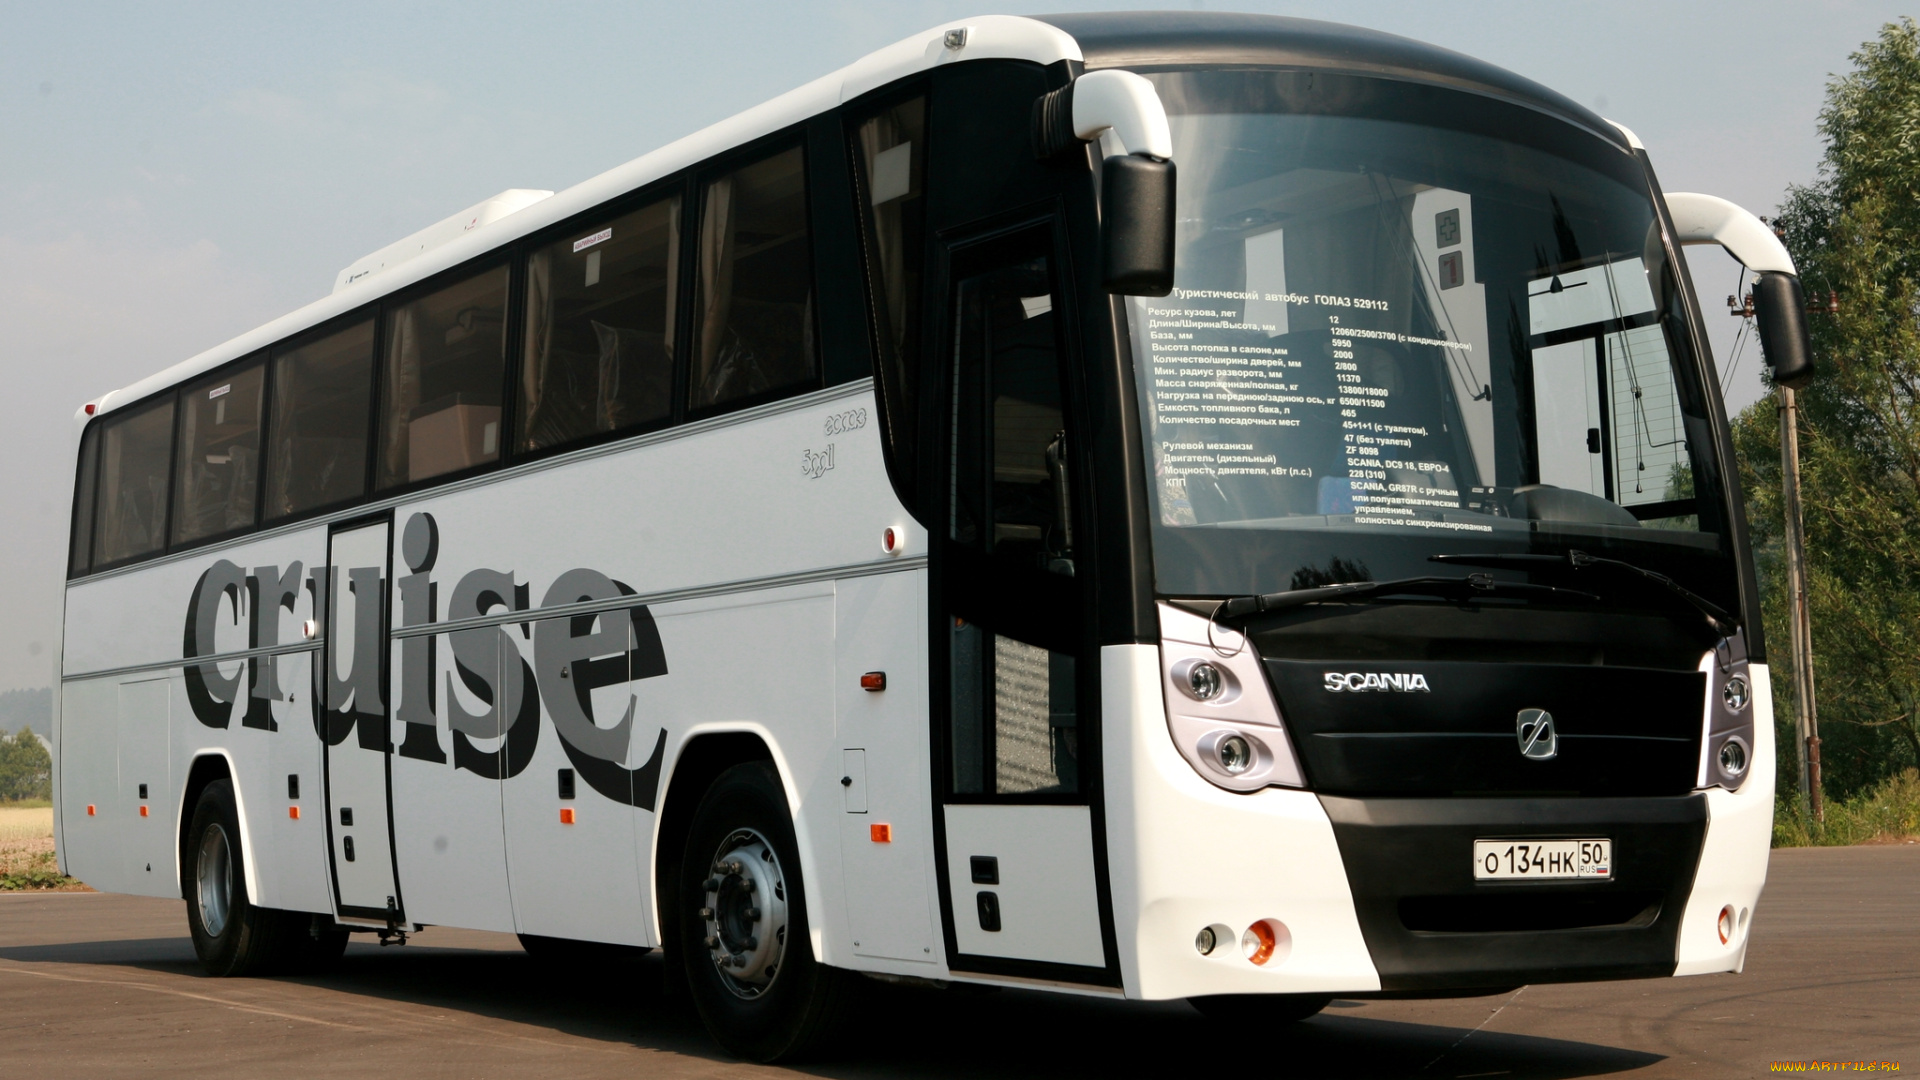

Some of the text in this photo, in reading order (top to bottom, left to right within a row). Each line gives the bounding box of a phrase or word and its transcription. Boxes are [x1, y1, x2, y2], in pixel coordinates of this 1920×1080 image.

[1172, 288, 1388, 310] Туристический автобус ГОЛАЗ 529112
[1148, 308, 1182, 317] Ресурс
[1184, 309, 1218, 318] кузова,
[1150, 331, 1177, 341] База,
[1330, 328, 1472, 352] 12060/2500/3700 (с кондиционером)
[1152, 343, 1189, 352] Высота
[1332, 339, 1351, 348] 5950
[1334, 351, 1353, 359] 2000
[1153, 356, 1248, 366] Количество/ширина
[1250, 358, 1286, 368] дверей,
[1335, 362, 1357, 371] 2/800
[1180, 368, 1213, 378] радиус
[1216, 369, 1267, 378] разворота,
[1337, 374, 1361, 383] 11370
[1338, 386, 1388, 397] 13800/18000
[1157, 392, 1200, 401] Нагрузка
[1340, 398, 1385, 408] 6500/11500
[1258, 405, 1282, 414] бака,
[1341, 409, 1356, 417] 465
[1219, 417, 1277, 425] посадочных
[1342, 421, 1372, 430] 45+1+1
[1374, 423, 1382, 432] (с
[1162, 441, 1204, 451] Рулевой
[1357, 436, 1374, 444] (без
[1376, 438, 1411, 448] туалета)
[1164, 454, 1277, 464] Двигатель (дизельный)
[1347, 458, 1449, 472] SCANIA, DC9 18, ЕВРО-4
[1165, 467, 1215, 475] Мощность
[1218, 467, 1269, 476] двигателя,
[1349, 470, 1386, 480] 228 (310)
[1165, 478, 1186, 487] КПП
[1351, 482, 1387, 492] SCANIA,
[1426, 488, 1458, 497] ручным
[1371, 496, 1459, 508] полуавтоматическим
[1355, 506, 1415, 516] управлением,
[1355, 517, 1404, 526] полностью
[184, 512, 668, 812] cruise
[1324, 672, 1430, 693] SCANIA
[1582, 843, 1602, 864] 50
